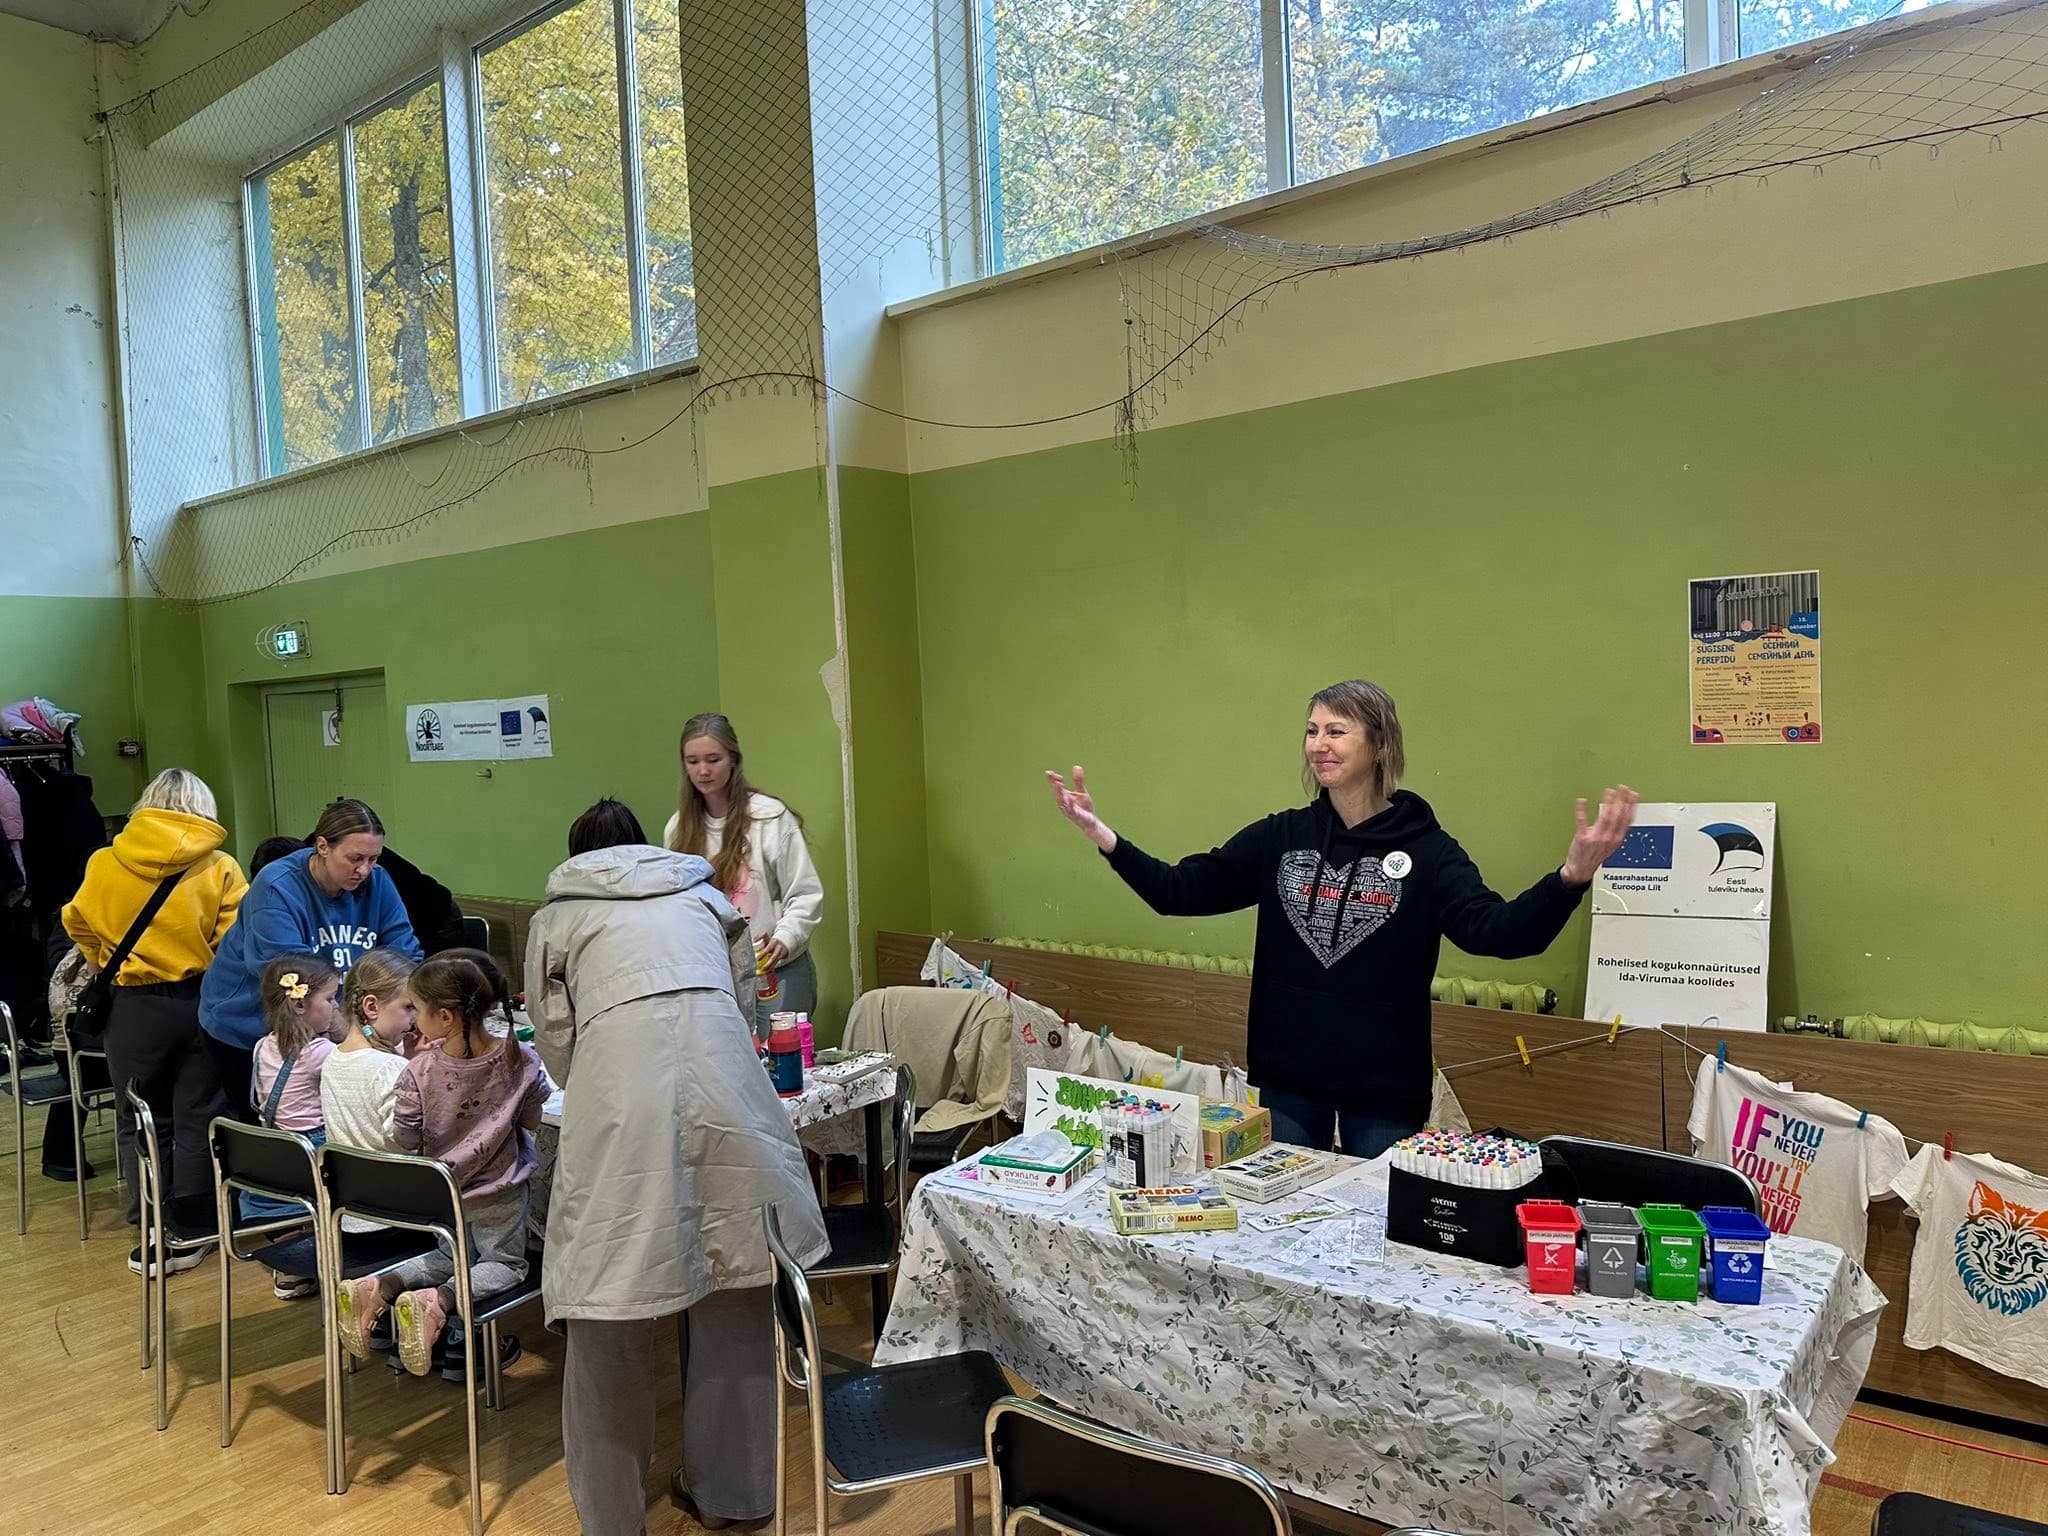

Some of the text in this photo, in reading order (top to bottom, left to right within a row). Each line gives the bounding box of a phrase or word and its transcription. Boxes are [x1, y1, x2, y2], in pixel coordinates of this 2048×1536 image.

[1747, 650, 1815, 661] СЕМЕЙНЫЙ ДЕНЬ
[1603, 873, 1669, 882] Kaasrahastanud
[1726, 877, 1747, 885] Eesti
[1611, 883, 1662, 892] Euroopa Liit
[1708, 885, 1765, 894] tuleviku heaks
[333, 948, 352, 968] 91
[1597, 957, 1761, 974] Rohelised kogukonnaüritused
[1619, 972, 1736, 988] Ida-Virumaa koolides
[1732, 1097, 1825, 1152] IF YOU
[1774, 1135, 1817, 1163] NEVER
[1003, 1170, 1040, 1180] PUTUKAD
[1732, 1146, 1803, 1200] YOU'LL
[1137, 1187, 1196, 1196] MEMO
[1760, 1184, 1801, 1214] NEVER
[1177, 1214, 1204, 1223] MEMO
